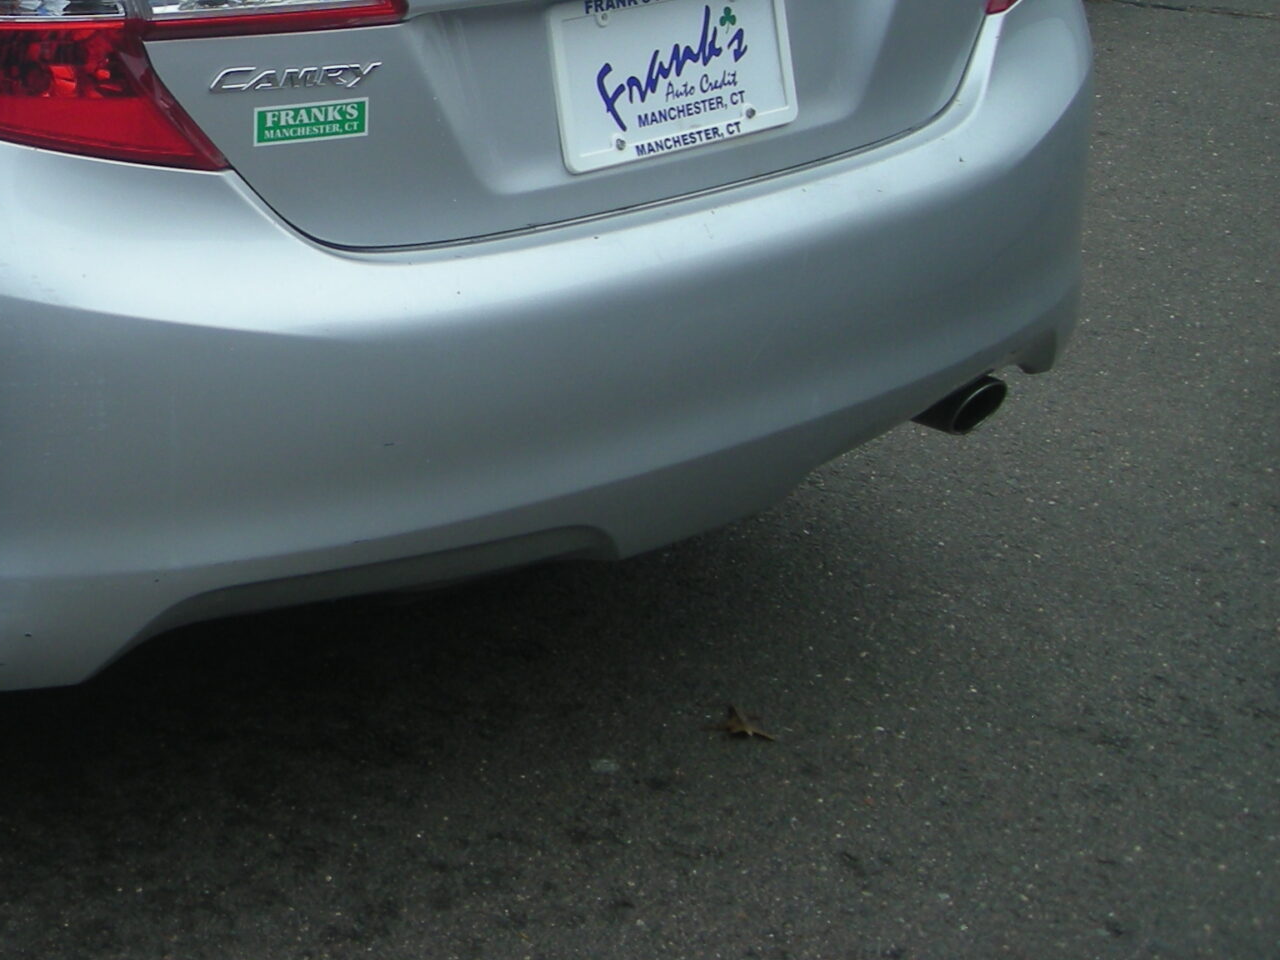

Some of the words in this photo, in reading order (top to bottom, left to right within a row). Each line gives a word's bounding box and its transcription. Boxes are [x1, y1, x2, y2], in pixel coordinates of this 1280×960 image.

[209, 61, 383, 92] CAMRY
[596, 4, 748, 132] Frank's
[665, 81, 696, 103] Auto
[699, 70, 739, 94] Credit
[264, 103, 359, 127] FRANK'S
[637, 96, 728, 128] MANCHESTER,
[730, 91, 746, 106] CT
[264, 124, 343, 139] MANCHESTER,
[344, 121, 360, 132] CT
[635, 125, 725, 157] MANCHESTER,
[726, 121, 742, 135] CT
